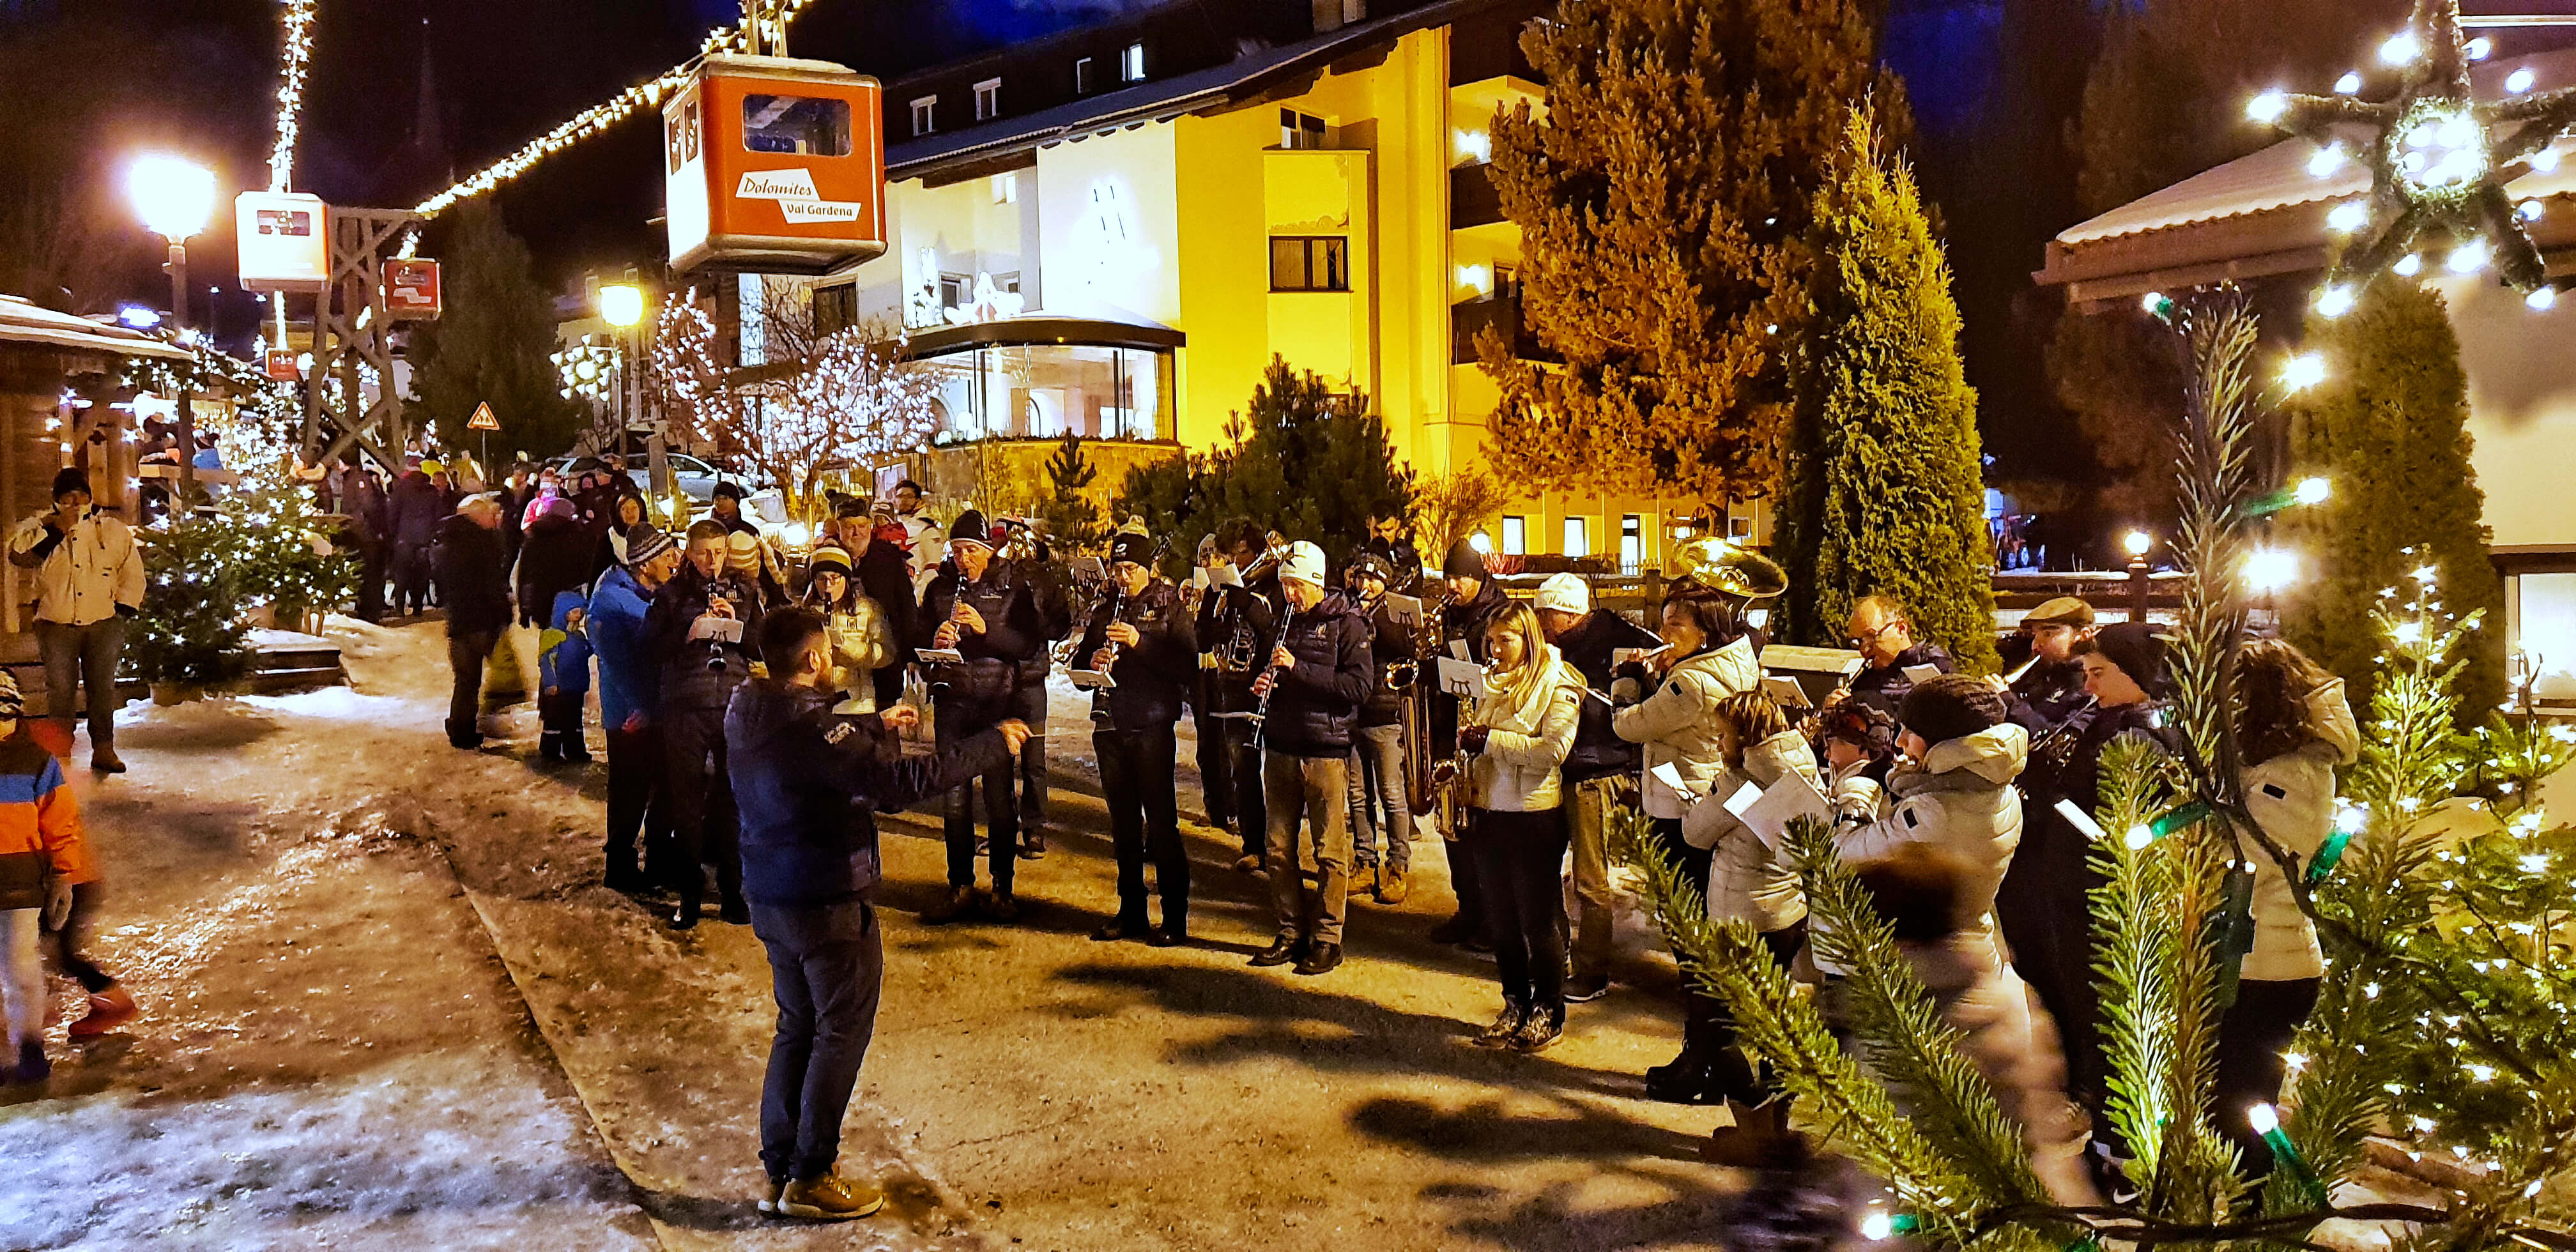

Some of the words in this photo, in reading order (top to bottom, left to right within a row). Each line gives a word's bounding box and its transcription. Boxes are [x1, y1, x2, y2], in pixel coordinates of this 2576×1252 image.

[744, 177, 811, 196] Dolomites
[786, 204, 804, 215] Val
[808, 204, 853, 217] Gardena
